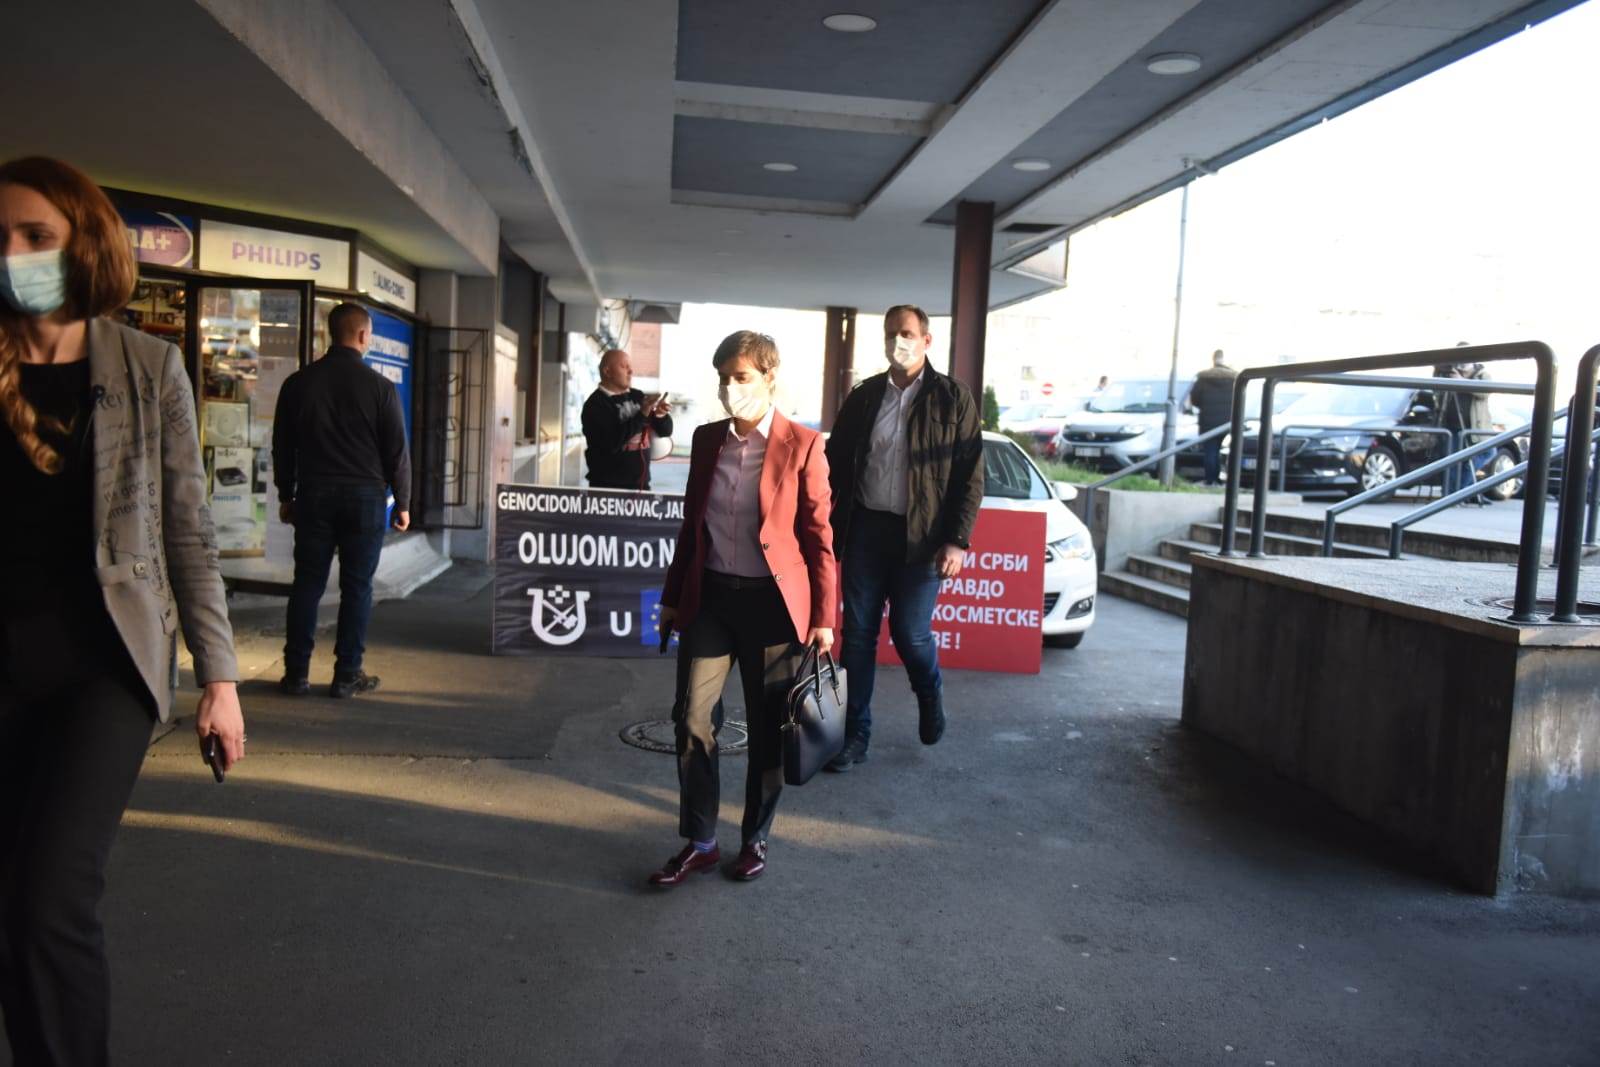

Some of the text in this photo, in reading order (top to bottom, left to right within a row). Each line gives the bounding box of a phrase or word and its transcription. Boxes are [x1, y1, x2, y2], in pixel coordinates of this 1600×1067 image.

[232, 240, 321, 271] PHILIPS
[498, 492, 582, 513] GENOCIDOM
[584, 497, 662, 520] JASENOVAC,
[518, 532, 618, 567] OLUJOM
[624, 541, 653, 568] DO
[980, 552, 1028, 573] СРБИ
